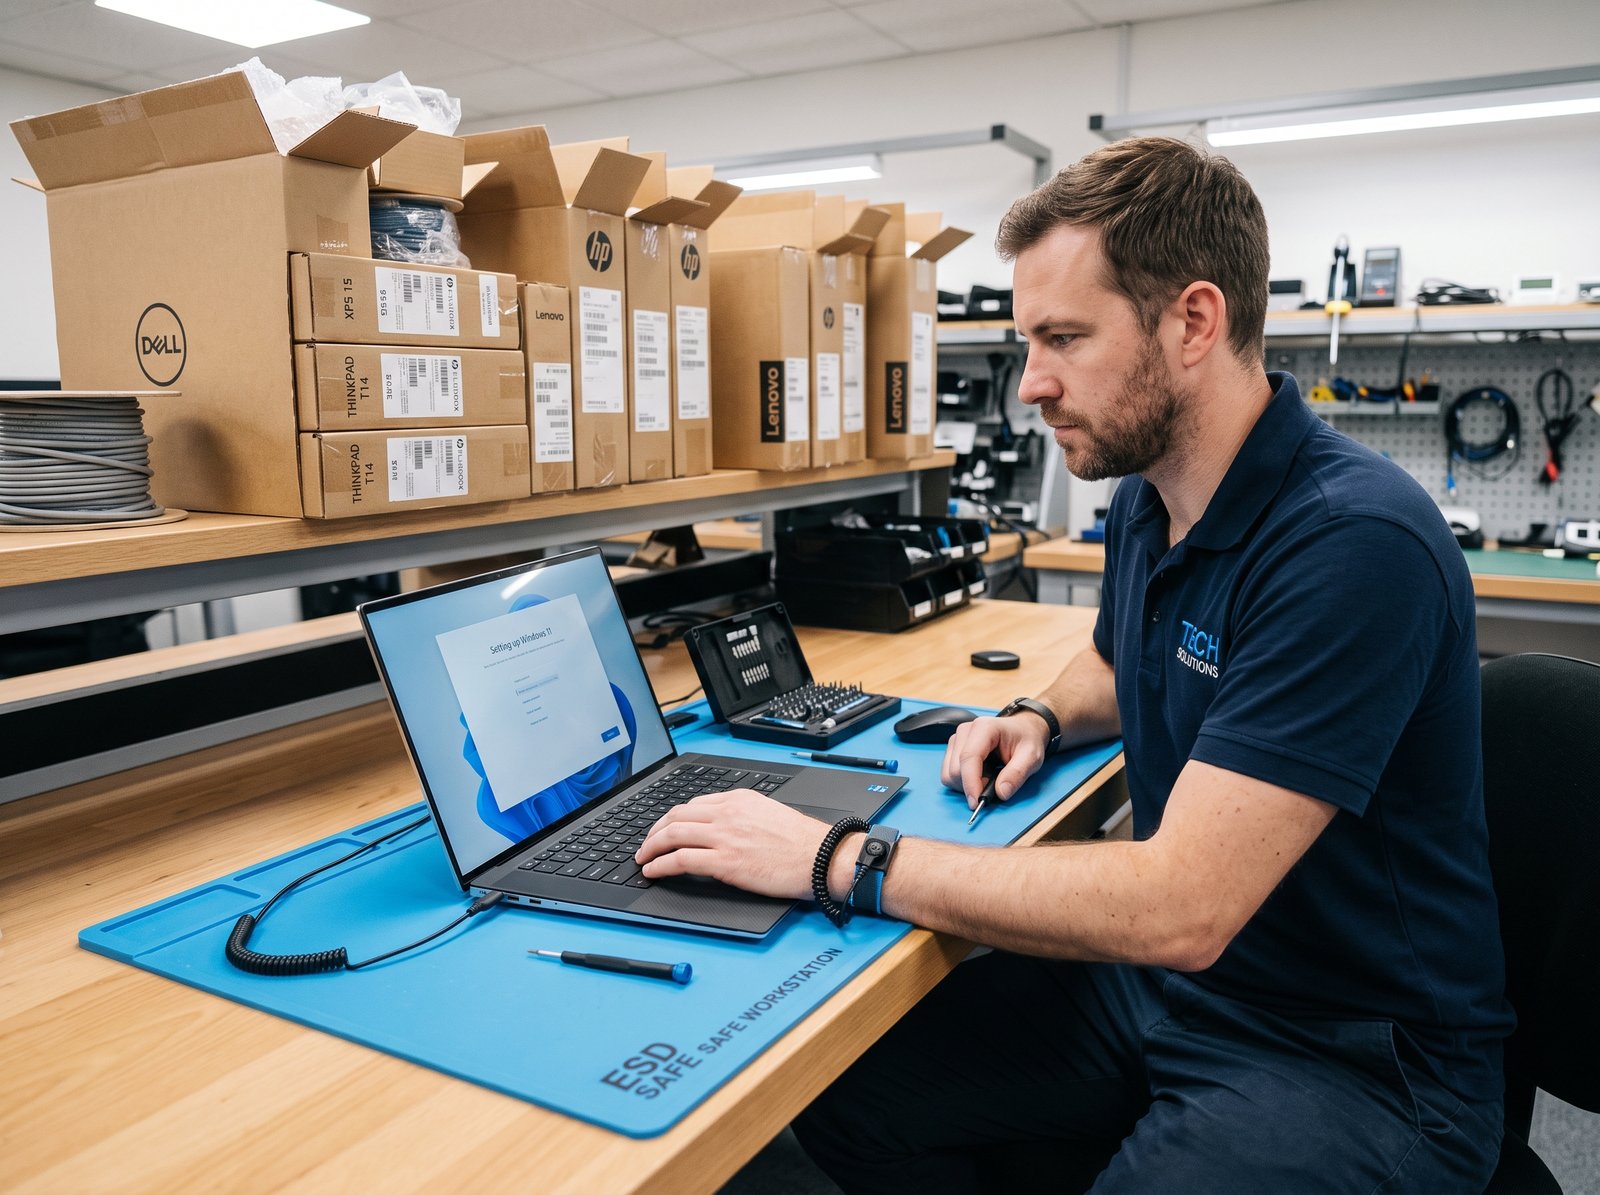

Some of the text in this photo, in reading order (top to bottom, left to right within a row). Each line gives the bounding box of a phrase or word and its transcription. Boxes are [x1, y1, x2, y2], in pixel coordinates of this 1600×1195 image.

[586, 230, 613, 272] hp
[681, 244, 700, 280] hp
[342, 277, 354, 320] XPS 15
[535, 310, 564, 321] Lenovo
[141, 335, 181, 355] DELL
[344, 355, 357, 418] THINKPAD
[360, 376, 370, 400] T14
[766, 367, 779, 436] Lenovo
[890, 367, 903, 429] Lenovo
[349, 443, 362, 504] THINKPAD
[365, 462, 375, 485] T14
[490, 639, 512, 655] Setting
[512, 638, 521, 649] up
[520, 630, 547, 645] Windows
[1182, 620, 1220, 663] TECH
[1176, 647, 1219, 679] SOLUTIONS
[634, 947, 843, 1100] SAFE SAFE WORKSTATION
[600, 1042, 678, 1092] ESD
